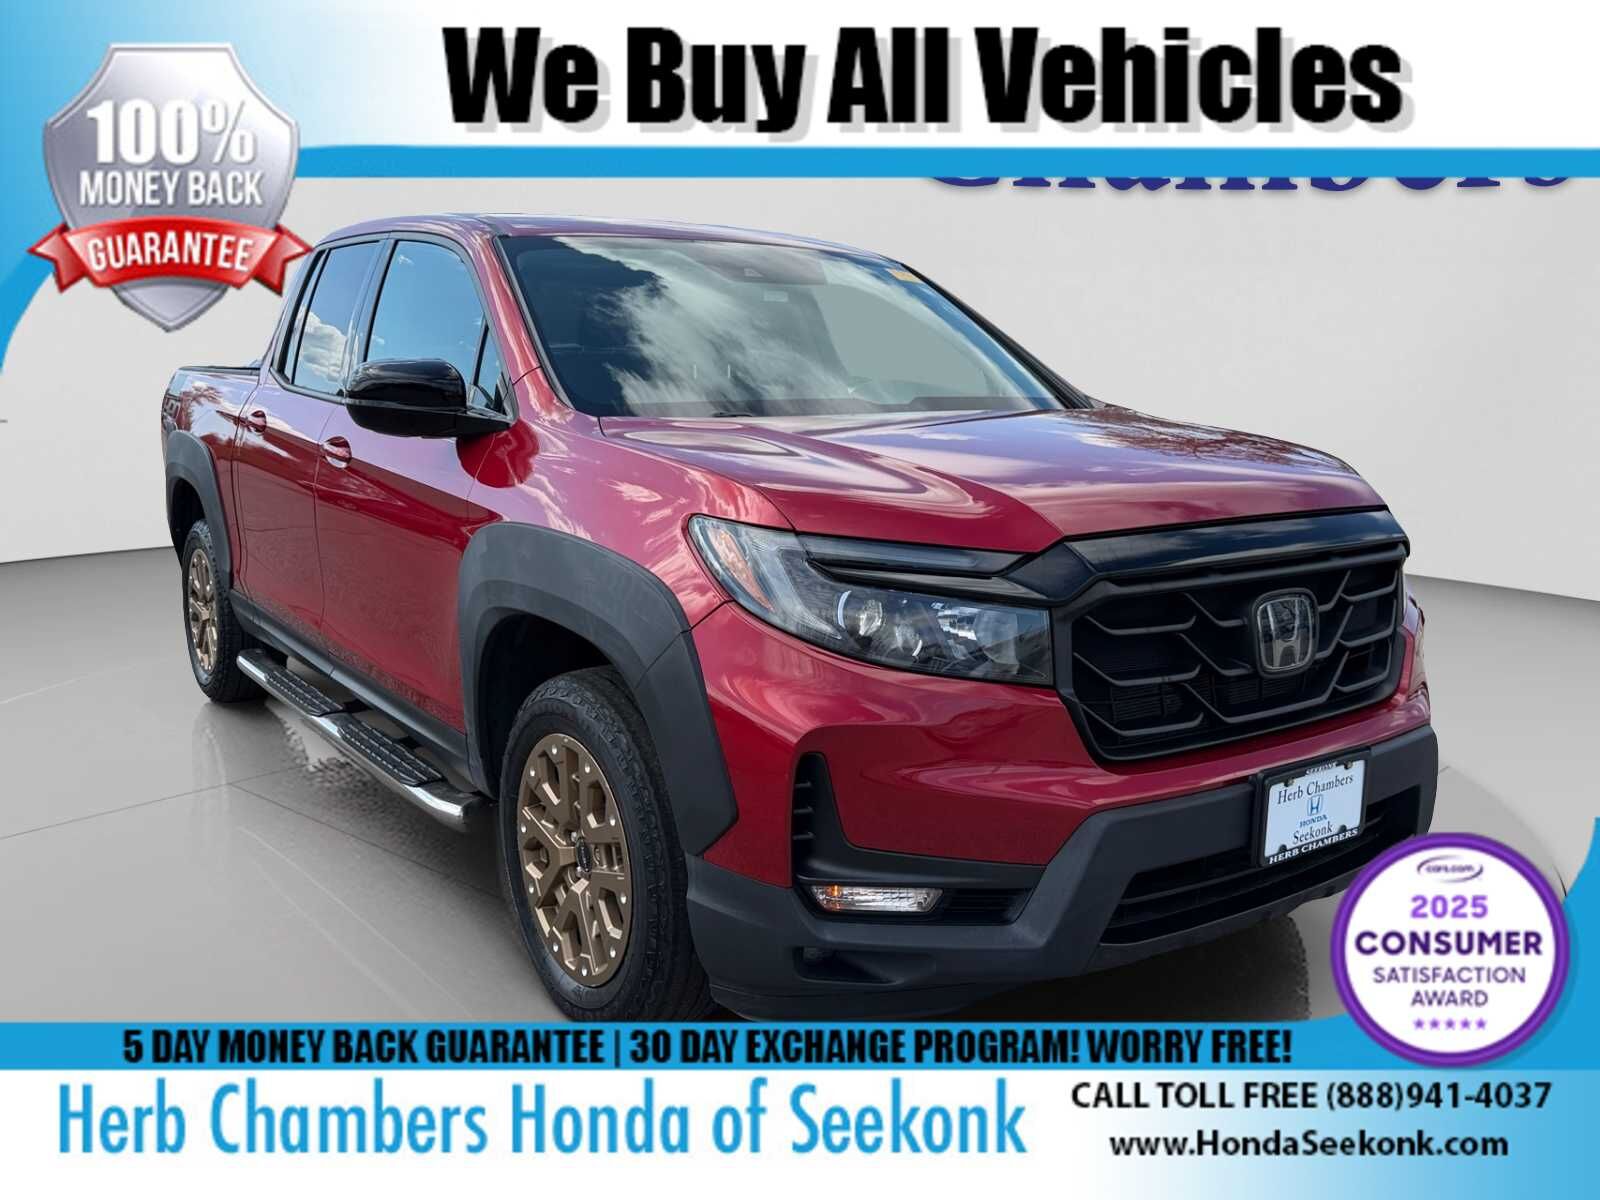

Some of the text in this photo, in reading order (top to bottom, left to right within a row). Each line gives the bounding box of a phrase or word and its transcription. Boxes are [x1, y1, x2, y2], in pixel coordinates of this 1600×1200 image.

[1277, 774, 1354, 804] Herb Chambers
[1292, 821, 1334, 845] Seekonk
[1300, 814, 1328, 827] HONDA
[1269, 828, 1359, 864] HERB CHAMBERS
